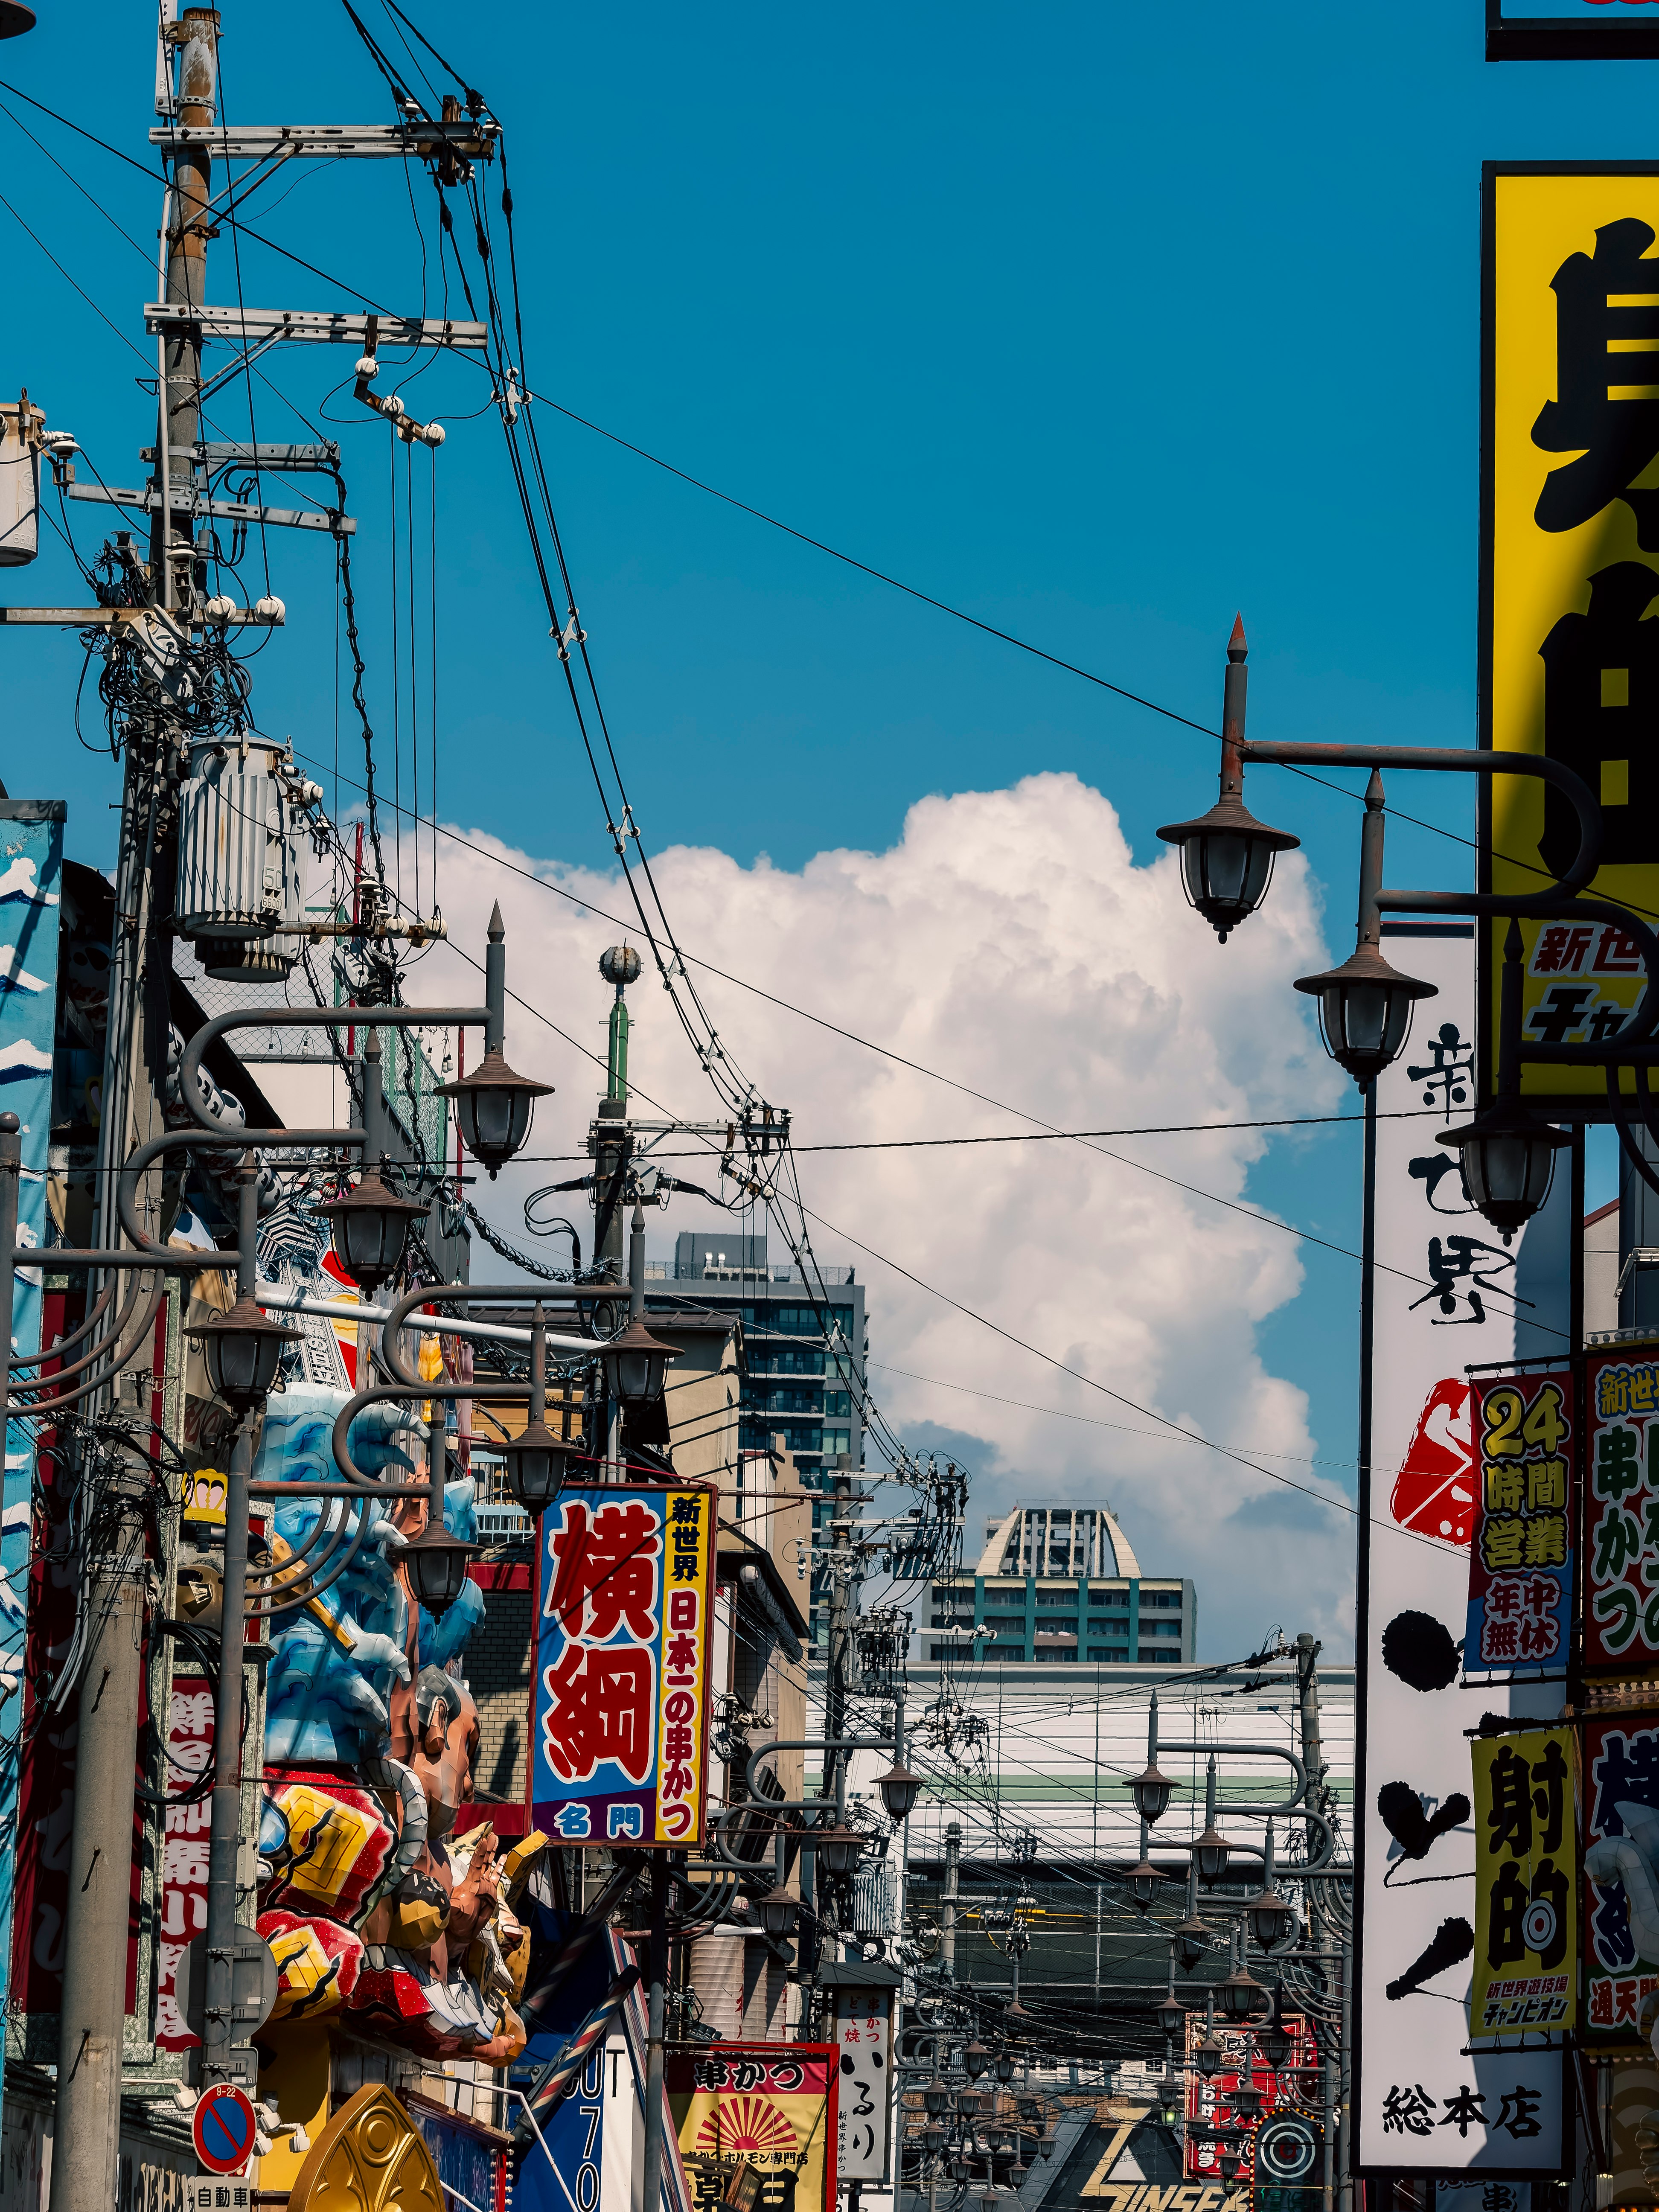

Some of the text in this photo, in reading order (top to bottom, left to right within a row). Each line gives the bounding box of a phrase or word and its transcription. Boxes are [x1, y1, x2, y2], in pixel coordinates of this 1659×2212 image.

[265, 867, 282, 890] 50
[1533, 926, 1650, 972] 新世
[1528, 988, 1648, 1042] チャ
[1601, 1369, 1659, 1416] 新世
[1482, 1384, 1568, 1457] 24
[1485, 1459, 1566, 1512] 時間
[671, 1497, 702, 1582] 新世界
[1484, 1516, 1566, 1569] 営業
[1595, 1424, 1641, 1651] 串かつ
[1489, 1578, 1560, 1621] 年中
[546, 1501, 660, 1782] 横綱
[1485, 1618, 1557, 1659] 無休
[661, 1590, 698, 1838] 日本一の串かつ
[556, 1805, 642, 1837] 名門
[1487, 1739, 1570, 1971] 射的
[1485, 1974, 1570, 2000] 新世界遊技場
[844, 1995, 861, 2043] どて焼
[866, 1997, 881, 2043] 串かつ
[1483, 1997, 1570, 2026] チャンピオン
[216, 2087, 236, 2098] 9-22
[695, 2060, 805, 2092] 串かつ
[840, 2051, 884, 2161] いるり
[1382, 2084, 1543, 2141] 総本店
[837, 2110, 848, 2172] 新世界串かつ
[198, 2186, 248, 2209] 自動車
